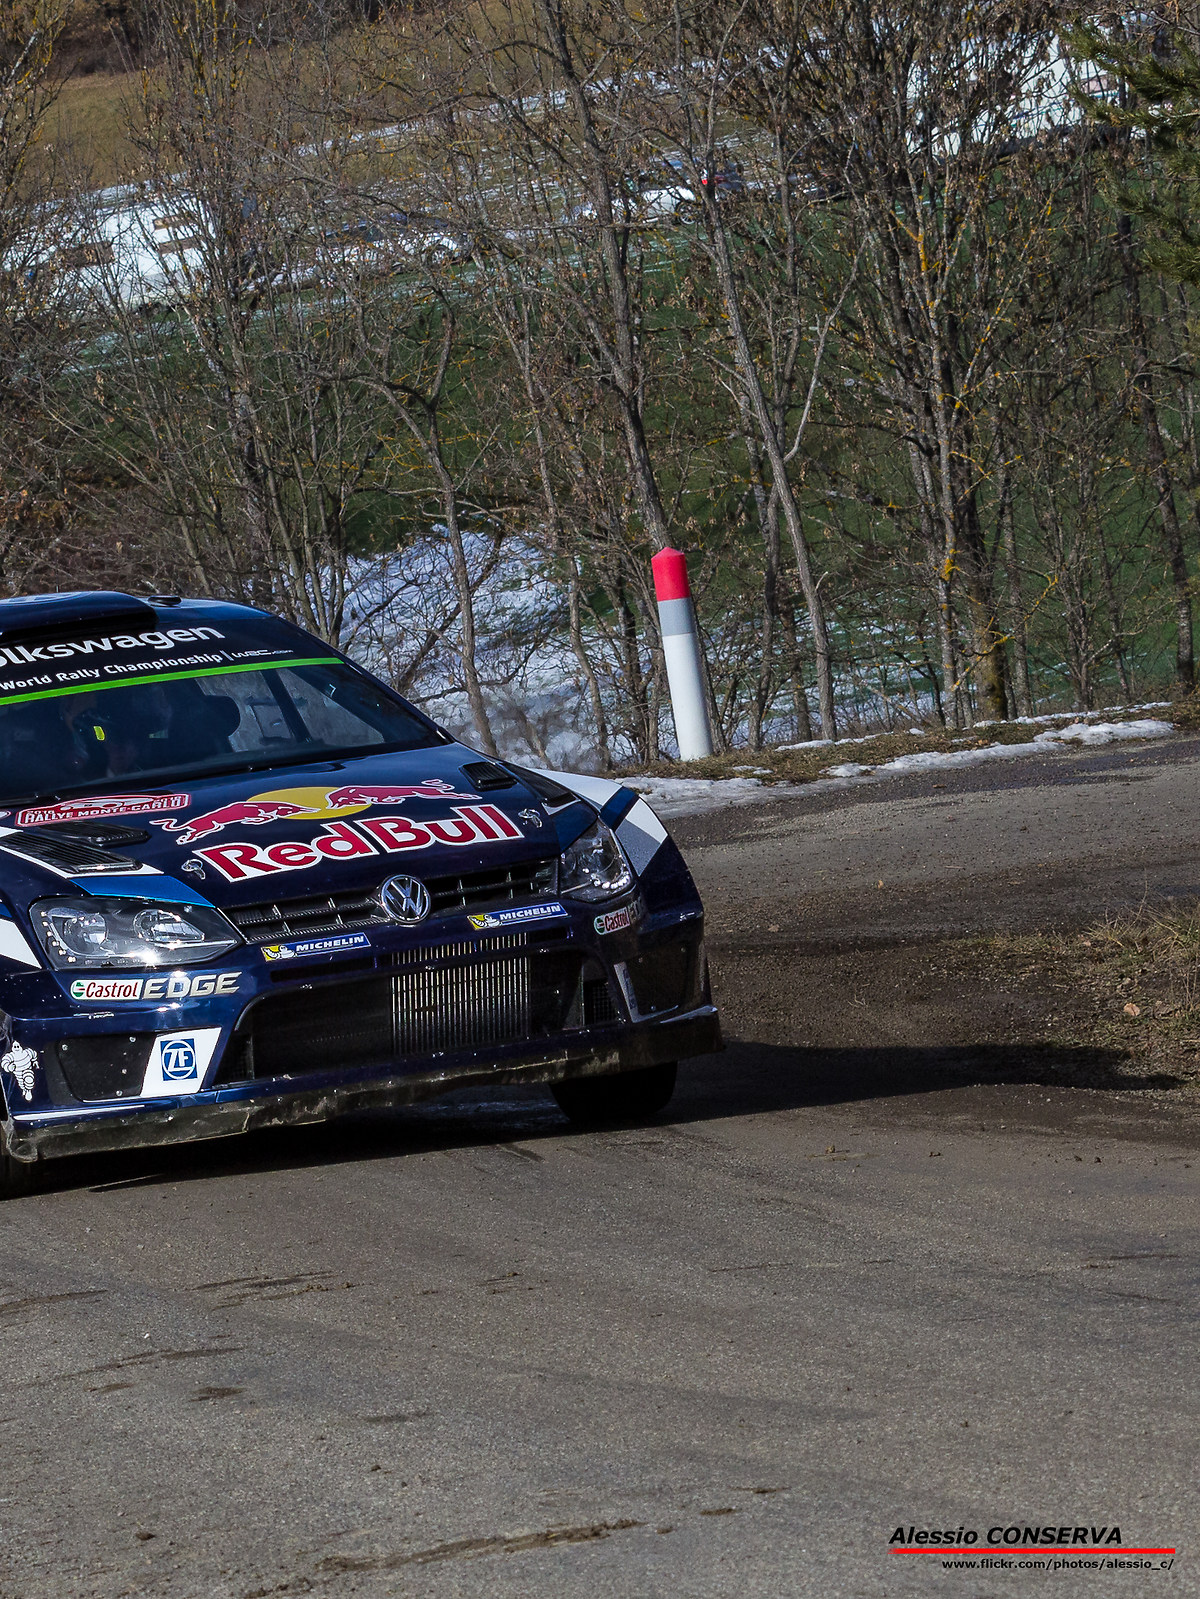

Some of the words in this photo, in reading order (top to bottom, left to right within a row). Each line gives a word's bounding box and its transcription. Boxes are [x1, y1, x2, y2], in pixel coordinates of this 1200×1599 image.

[55, 668, 101, 683] Rally
[103, 652, 223, 674] Championship
[24, 810, 74, 824] RALLYE
[201, 820, 379, 882] Red
[360, 804, 524, 853] Bull
[500, 904, 561, 920] MICHELIN
[295, 935, 365, 952] MICHELIN
[85, 981, 139, 998] Castrol
[141, 971, 242, 999] EDGE
[163, 1046, 195, 1073] ZF
